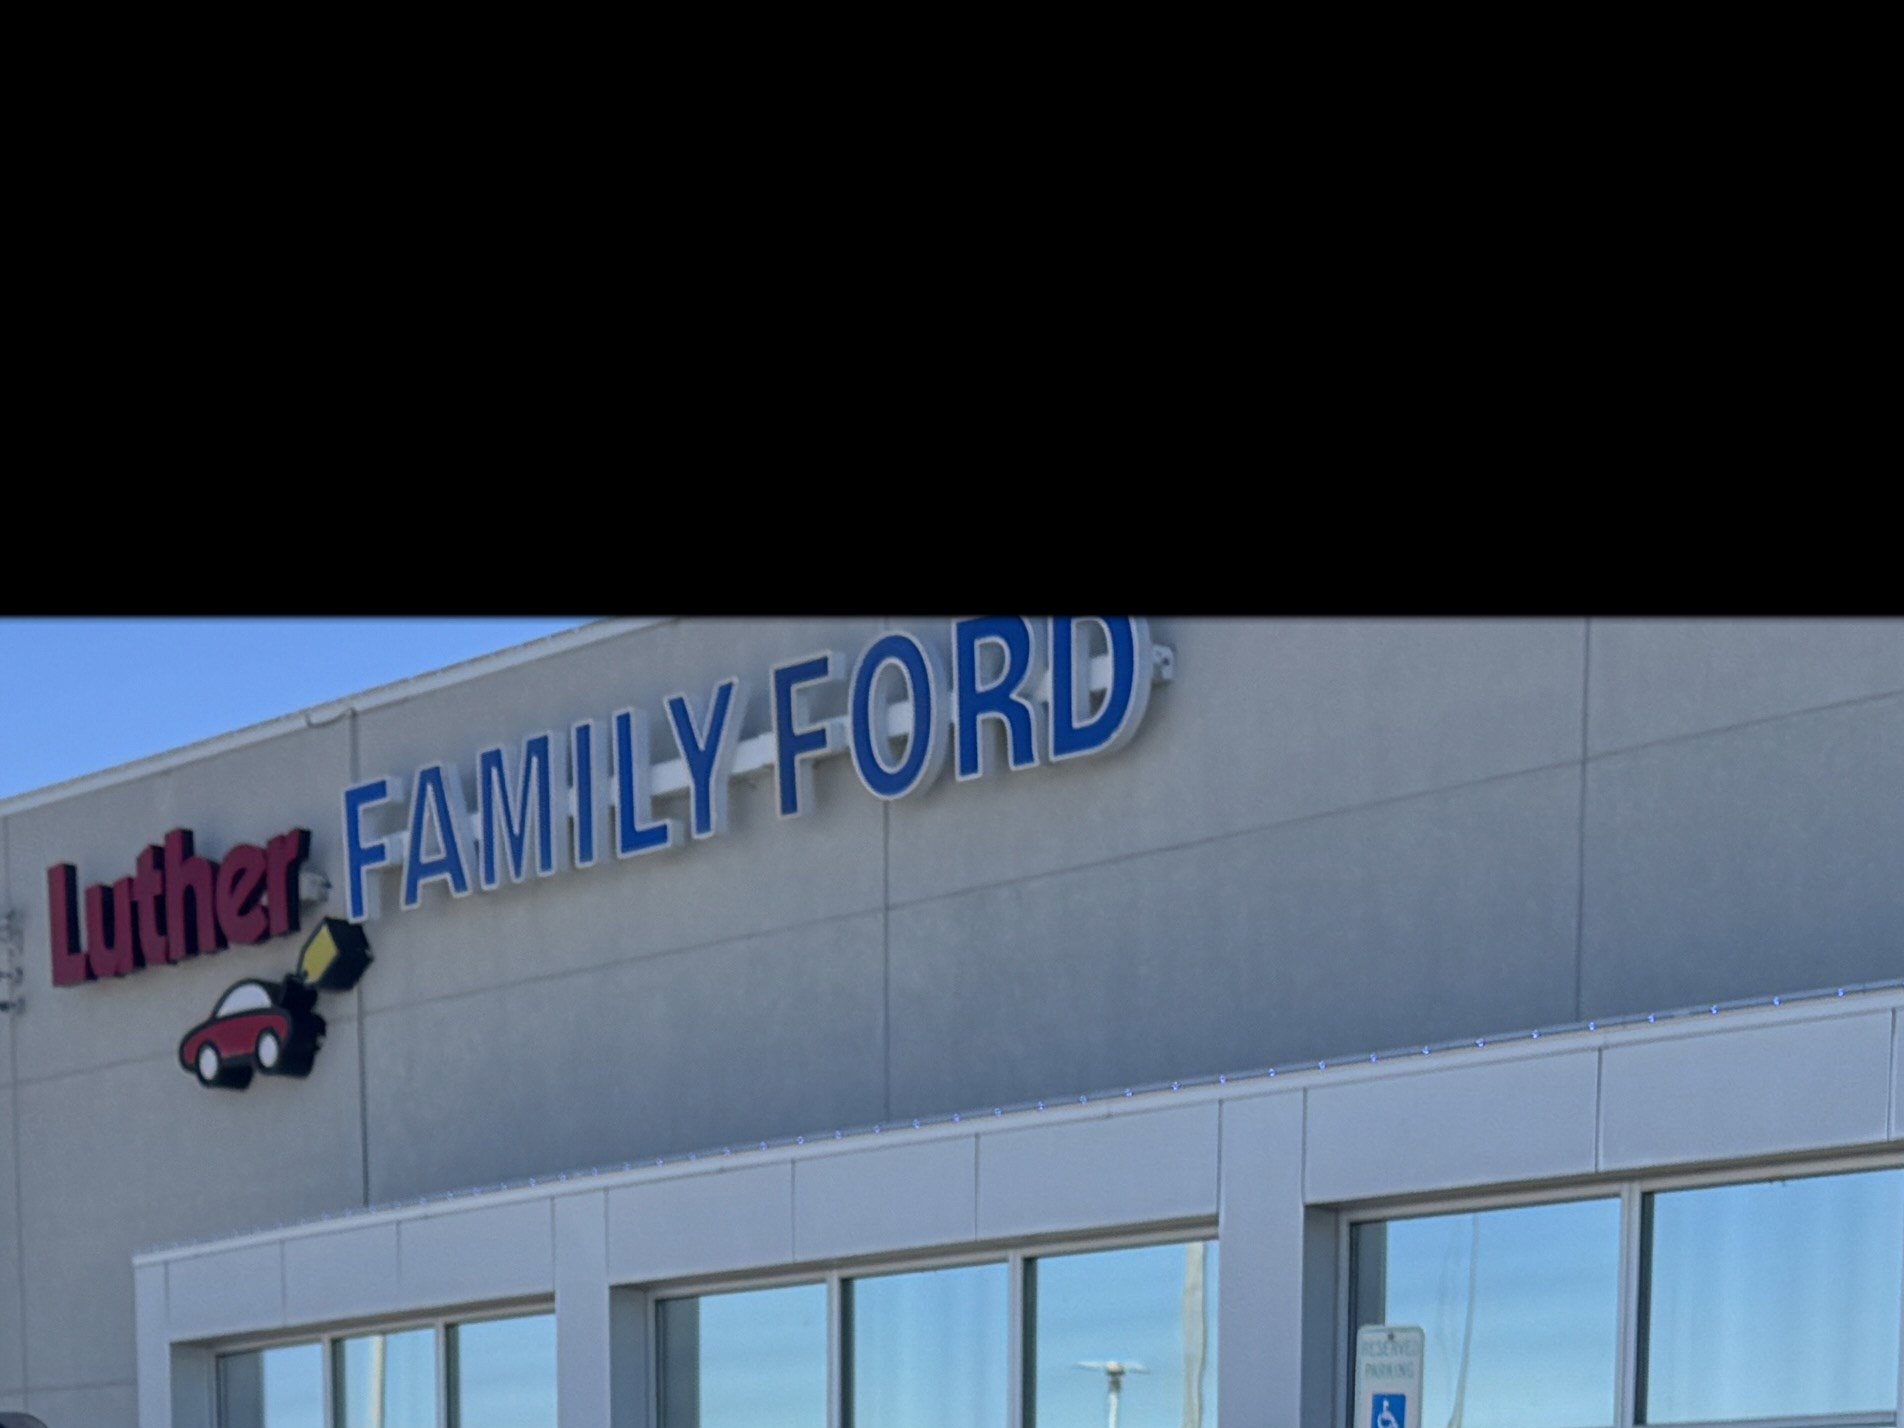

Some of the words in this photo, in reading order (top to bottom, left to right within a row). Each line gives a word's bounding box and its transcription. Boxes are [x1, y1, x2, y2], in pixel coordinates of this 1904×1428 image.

[342, 676, 741, 922] FAMILY
[771, 617, 1146, 818] FORD
[47, 826, 312, 988] Luther
